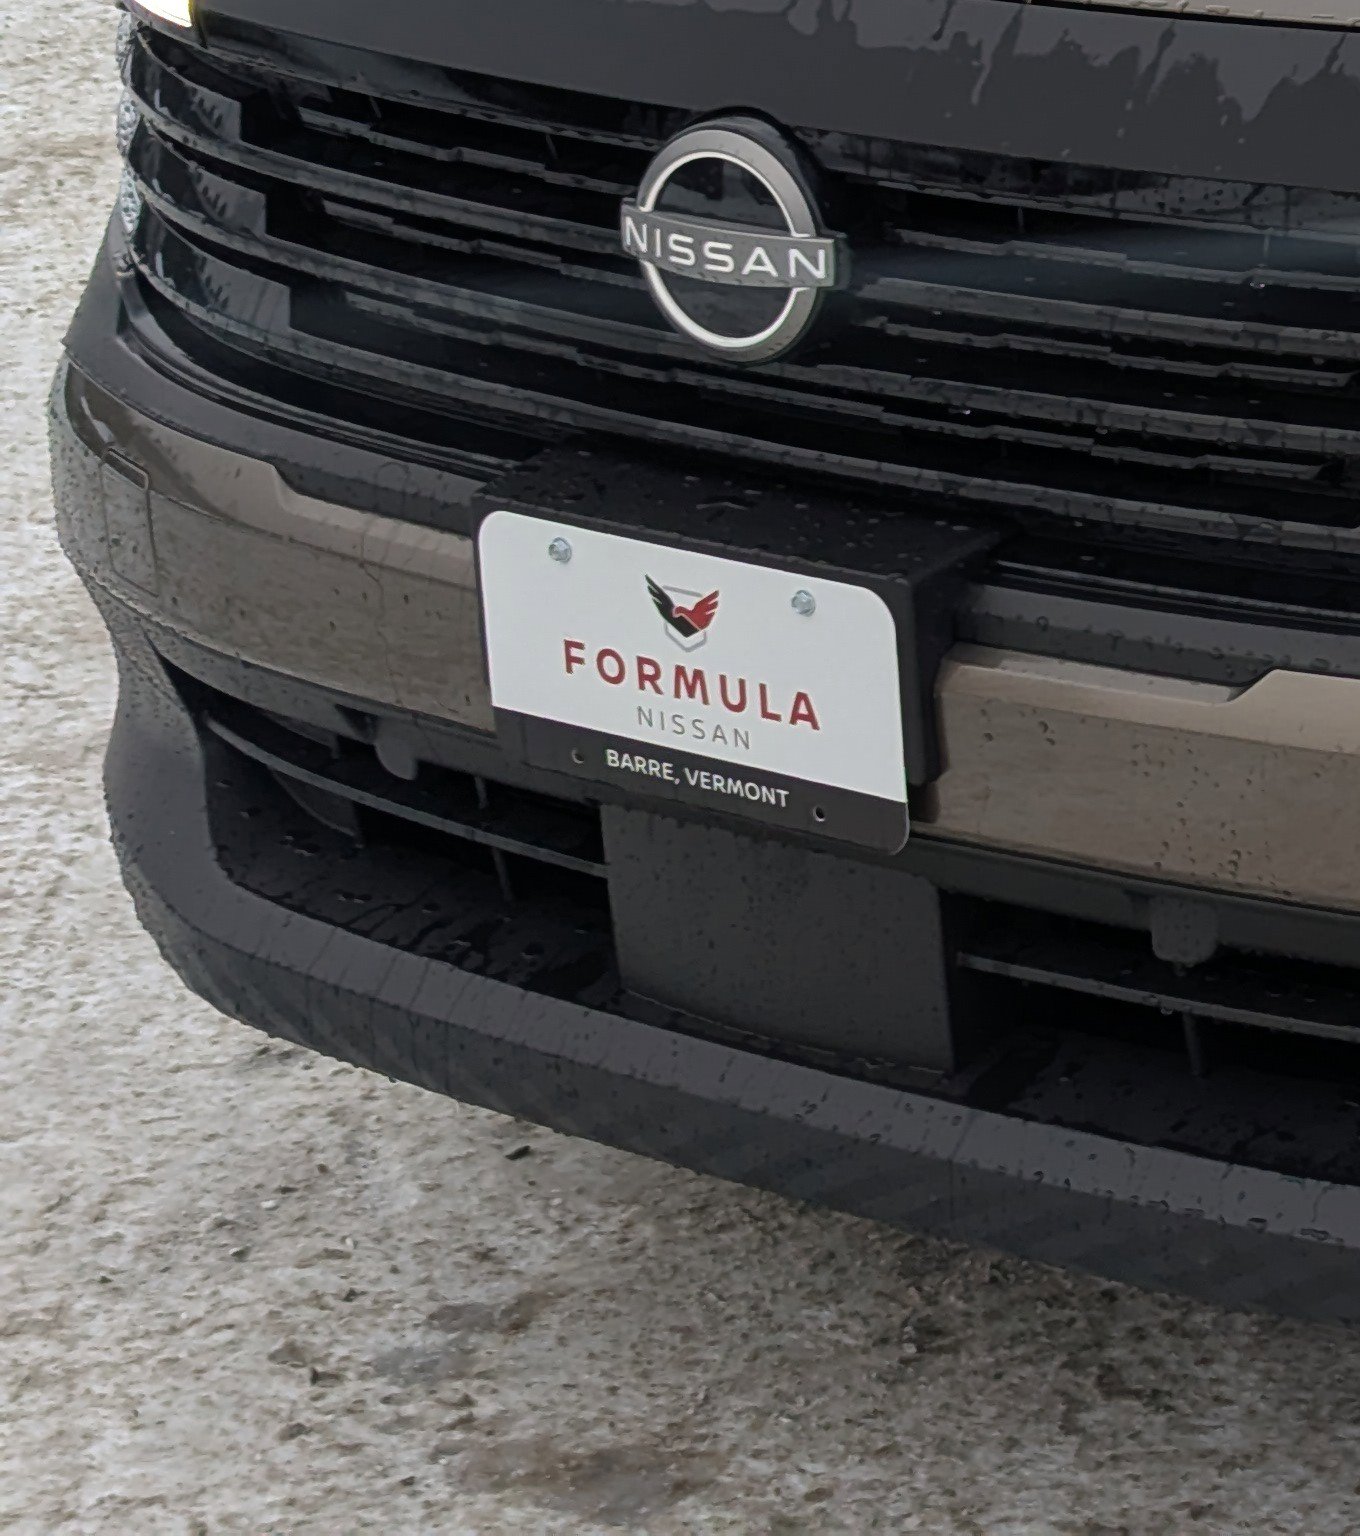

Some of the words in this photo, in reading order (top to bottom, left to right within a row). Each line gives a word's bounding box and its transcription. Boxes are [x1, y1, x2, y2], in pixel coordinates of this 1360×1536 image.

[624, 216, 826, 280] NISSAN
[562, 638, 821, 732] FORMULA
[636, 704, 752, 751] NISSAN
[605, 747, 681, 786] BARRE,
[684, 767, 790, 809] VERMONT
